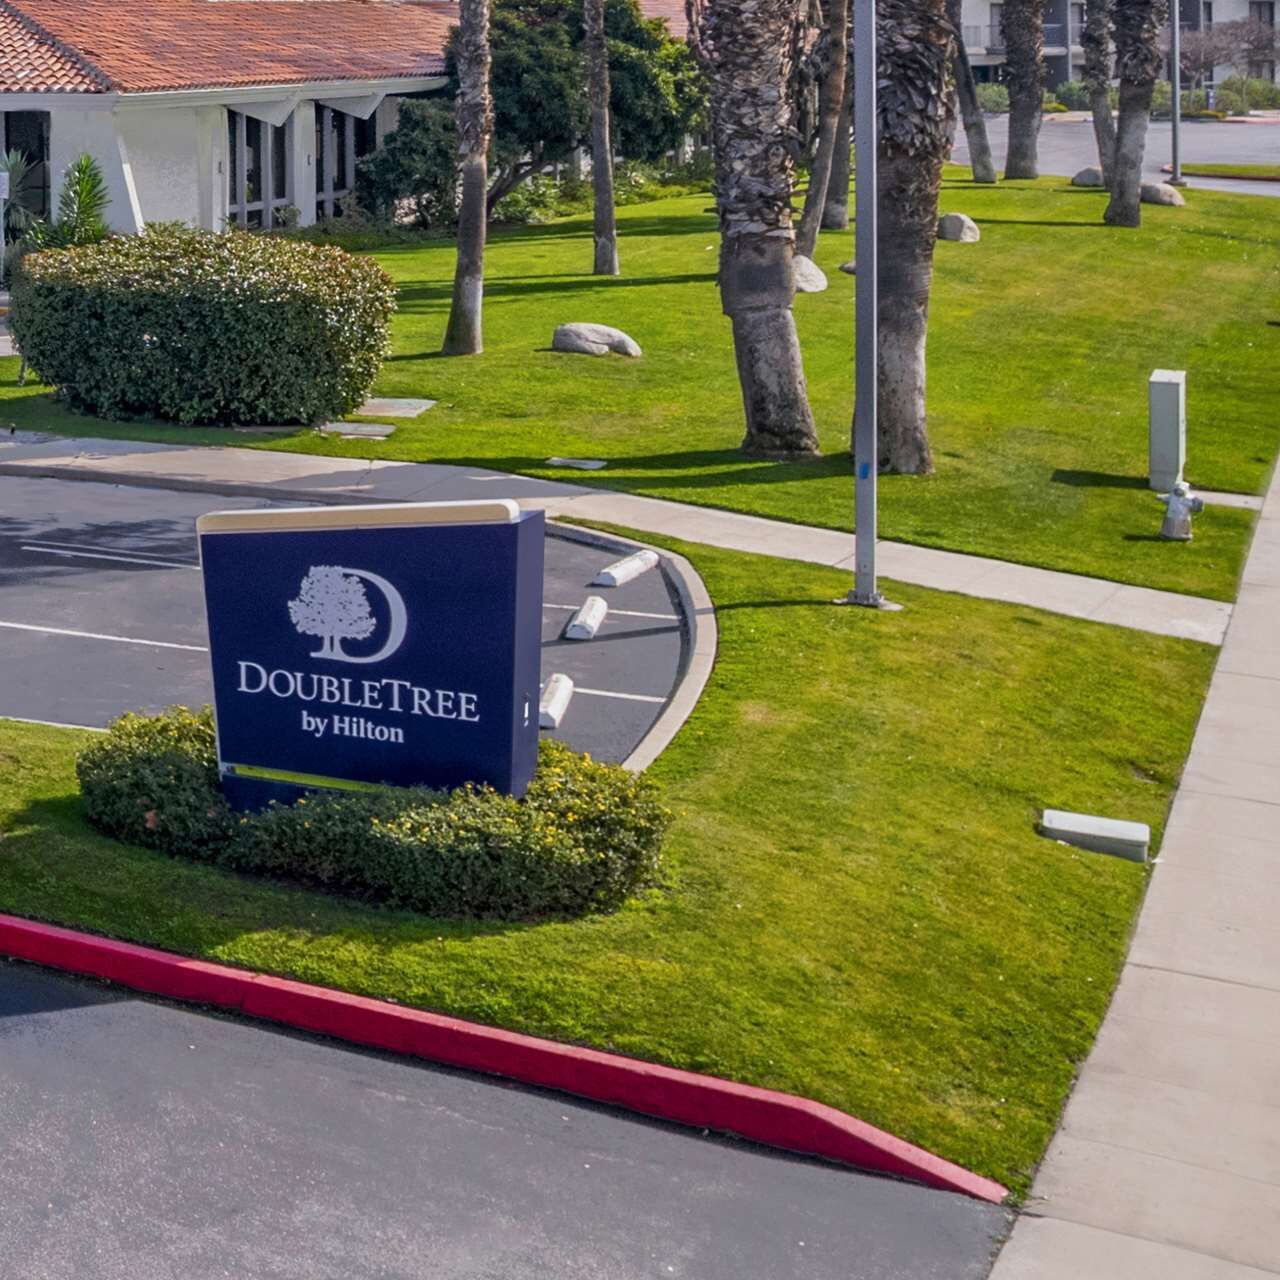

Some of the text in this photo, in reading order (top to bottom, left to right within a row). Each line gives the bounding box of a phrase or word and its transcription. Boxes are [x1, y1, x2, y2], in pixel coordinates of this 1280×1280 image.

[237, 660, 481, 722] DOUBLETREE
[301, 710, 405, 744] by Hilton
